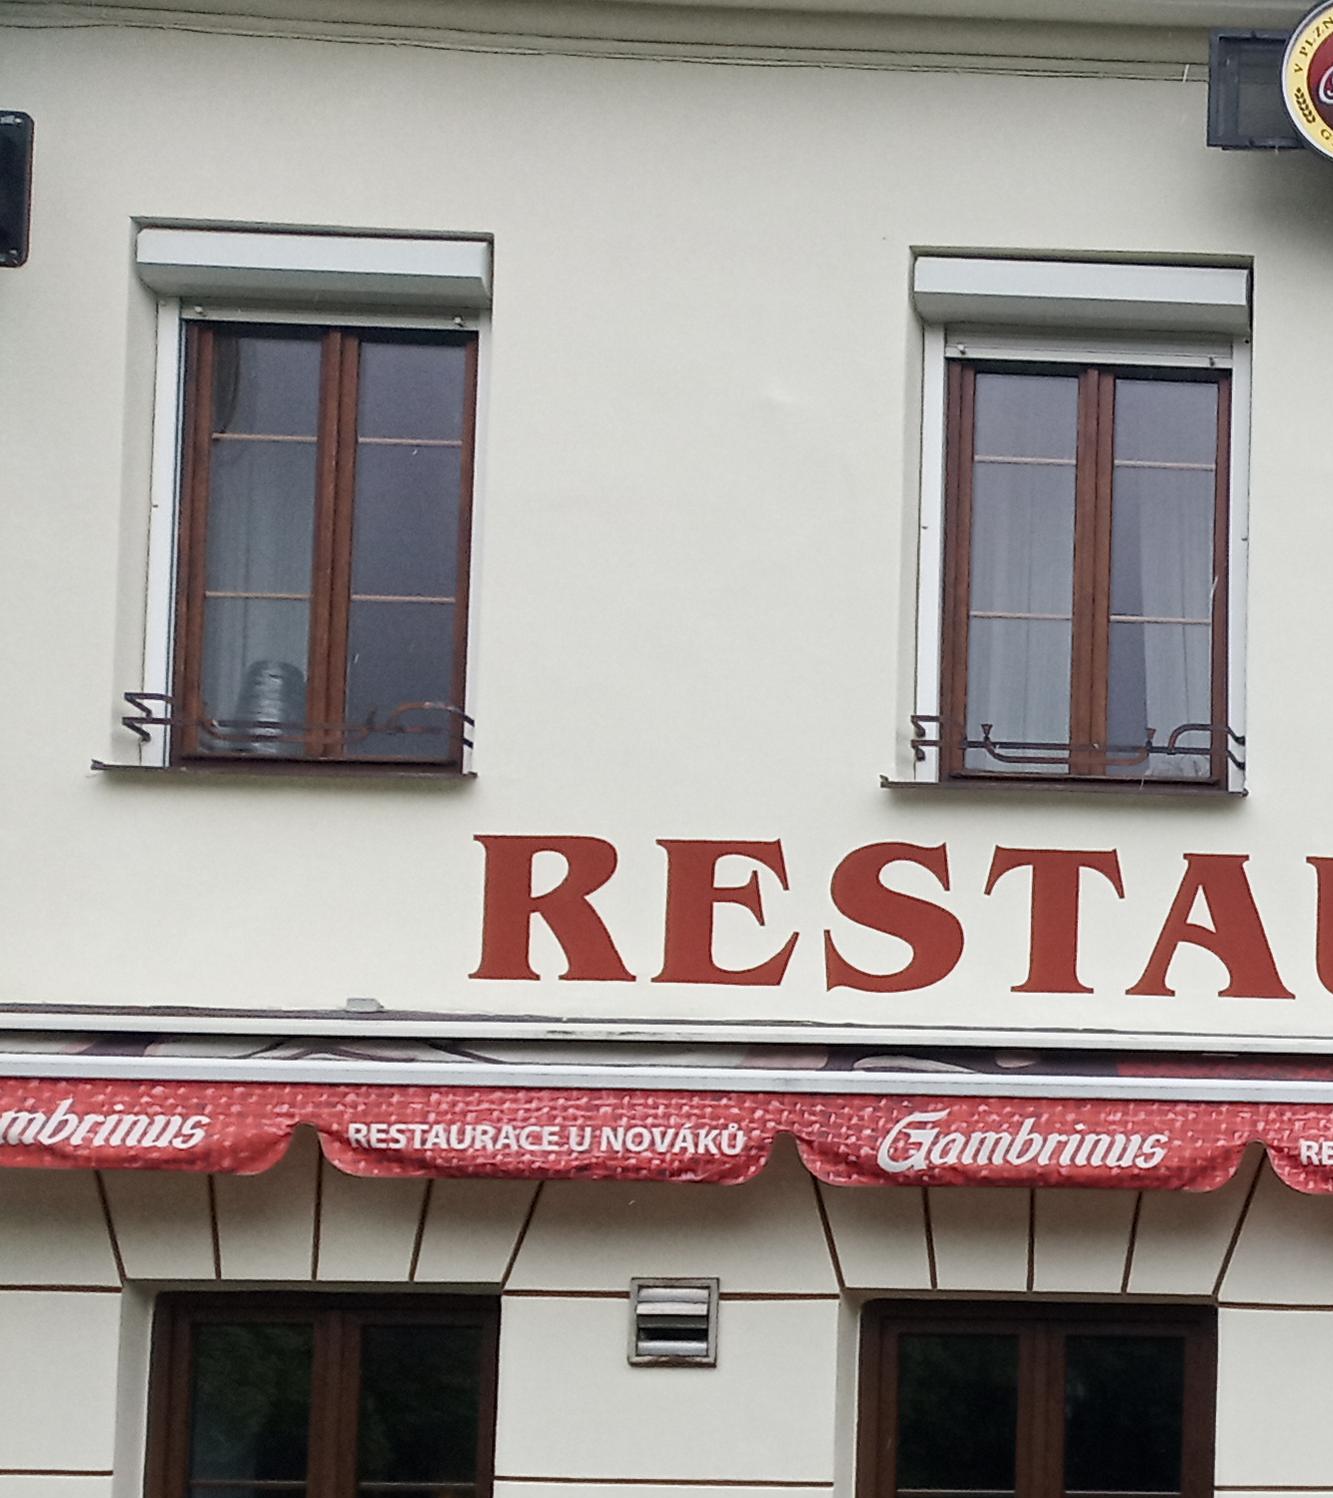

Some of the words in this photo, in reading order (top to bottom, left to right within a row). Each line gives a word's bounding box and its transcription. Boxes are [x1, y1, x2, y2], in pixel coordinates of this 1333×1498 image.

[1293, 63, 1304, 74] V
[347, 1122, 560, 1151] RESTAURACE
[568, 1125, 593, 1152] U
[600, 1123, 745, 1156] NOVÁKŮ
[876, 1107, 1170, 1174] Gambrinus
